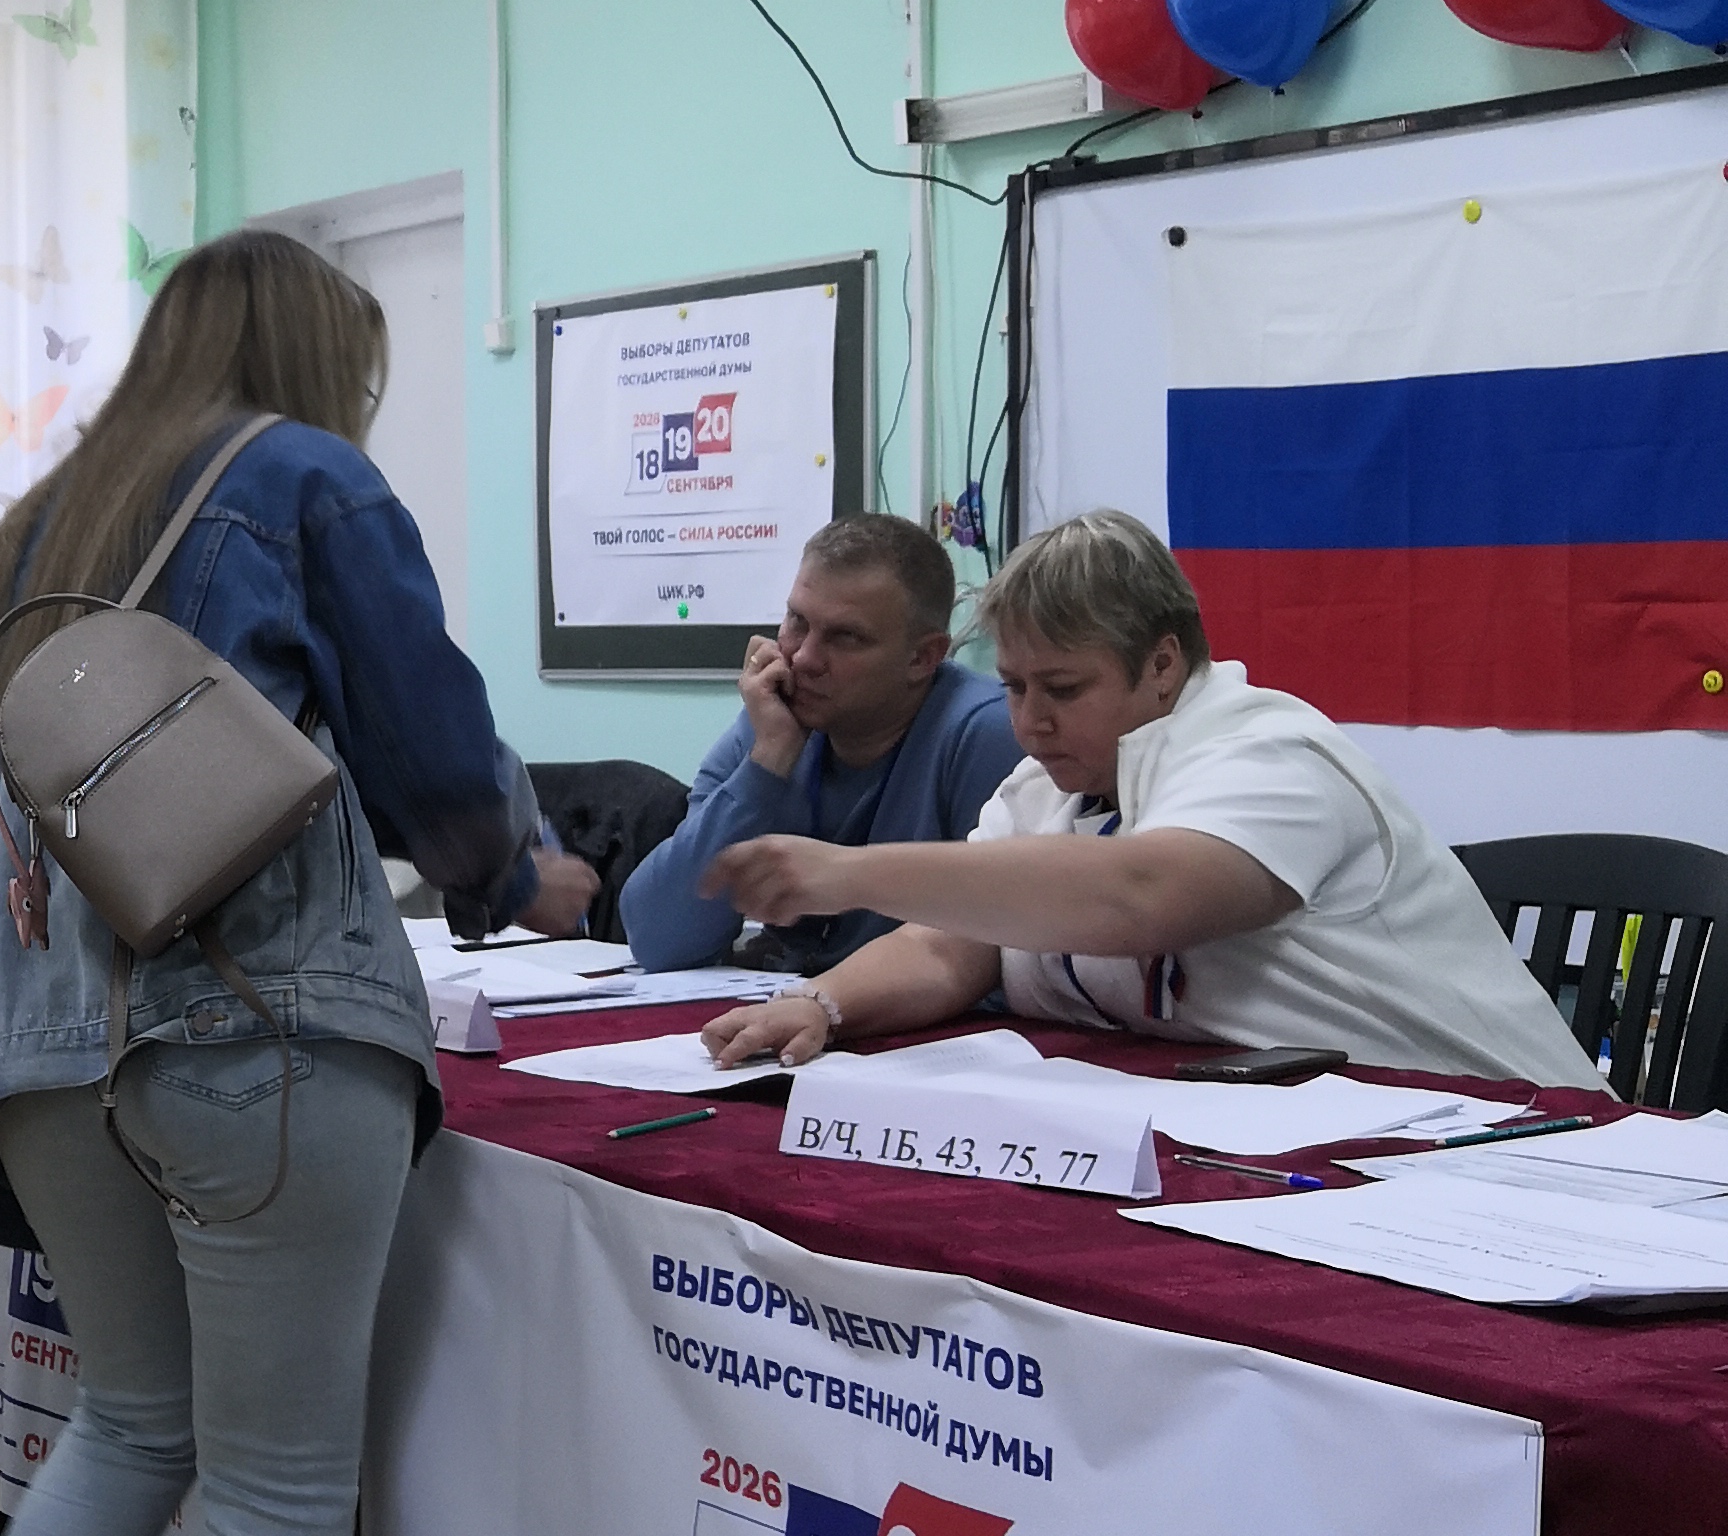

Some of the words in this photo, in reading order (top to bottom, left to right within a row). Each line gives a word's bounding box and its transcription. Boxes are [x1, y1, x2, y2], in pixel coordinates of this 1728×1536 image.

[621, 342, 672, 360] ВЫБОРЫ
[676, 332, 750, 355] ДЕПУТАТОВ
[617, 361, 716, 386] ГОСУДАРСТВЕННОЙ
[719, 361, 752, 376] ДУМЫ
[636, 449, 659, 480] 18
[665, 426, 692, 461] 19
[697, 406, 729, 442] 20
[667, 475, 733, 493] СЕНТЯБРЯ
[593, 527, 622, 545] ТВОЙ
[625, 529, 664, 543] ГОЛОС
[679, 526, 713, 541] СИЛА
[717, 524, 778, 540] РОССИИ!
[658, 584, 705, 601] ЦИК.РФ
[797, 1116, 862, 1161] В/Ч,
[877, 1127, 923, 1168] 1Б,
[936, 1136, 981, 1177] 43,
[999, 1143, 1042, 1184] 75,
[1059, 1150, 1098, 1186] 77
[652, 1254, 819, 1331] ВЫБОРЫ
[821, 1303, 1044, 1398] ДЕПУТАТОВ
[652, 1324, 939, 1447] ГОСУДАРСТВЕННОЙ
[945, 1419, 1053, 1482] ДУМЫ
[700, 1448, 782, 1508] 2026
